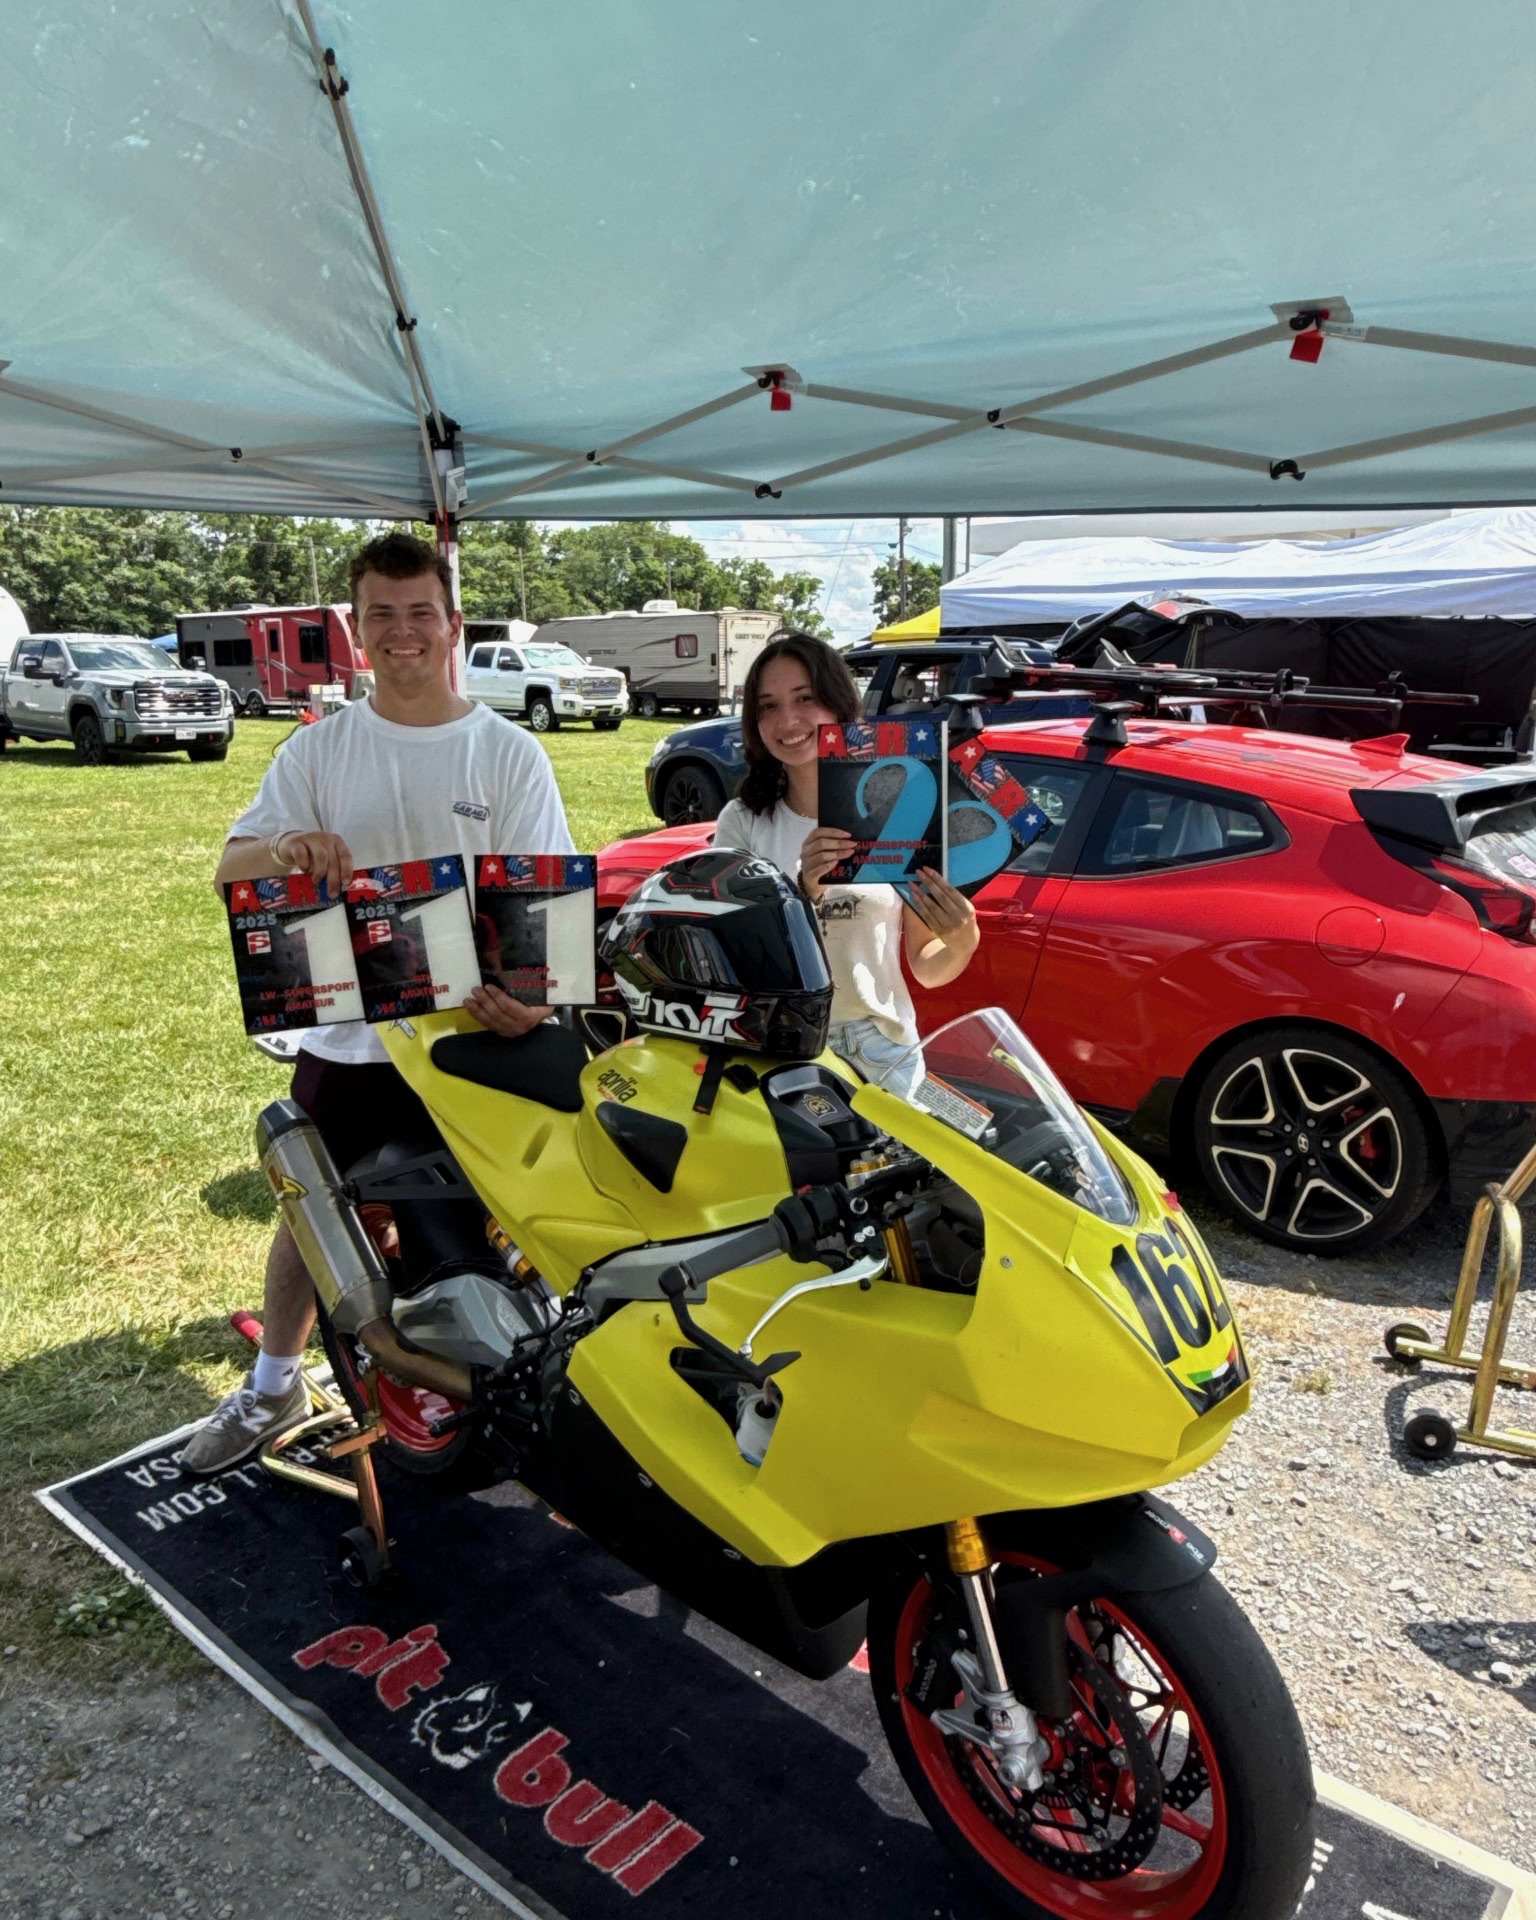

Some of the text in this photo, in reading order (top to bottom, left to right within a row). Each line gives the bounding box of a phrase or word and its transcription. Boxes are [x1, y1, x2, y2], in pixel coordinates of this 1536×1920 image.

[853, 756, 937, 882] 2
[855, 840, 928, 850] SUPERSPORT
[853, 855, 904, 864] AMATEUR
[235, 914, 277, 930] 2025
[355, 904, 397, 920] 2025
[401, 887, 484, 1011] 1
[527, 887, 596, 1004] 1
[284, 903, 366, 1024] 1
[284, 981, 356, 998] SUPERSPORT
[400, 984, 450, 999] AMATEUR
[285, 998, 336, 1012] AMATEUR
[252, 1012, 285, 1028] AMA
[597, 1069, 638, 1103] aprilia
[1110, 1216, 1232, 1366] 162
[292, 1623, 451, 1712] pit
[493, 1726, 705, 1896] bull
